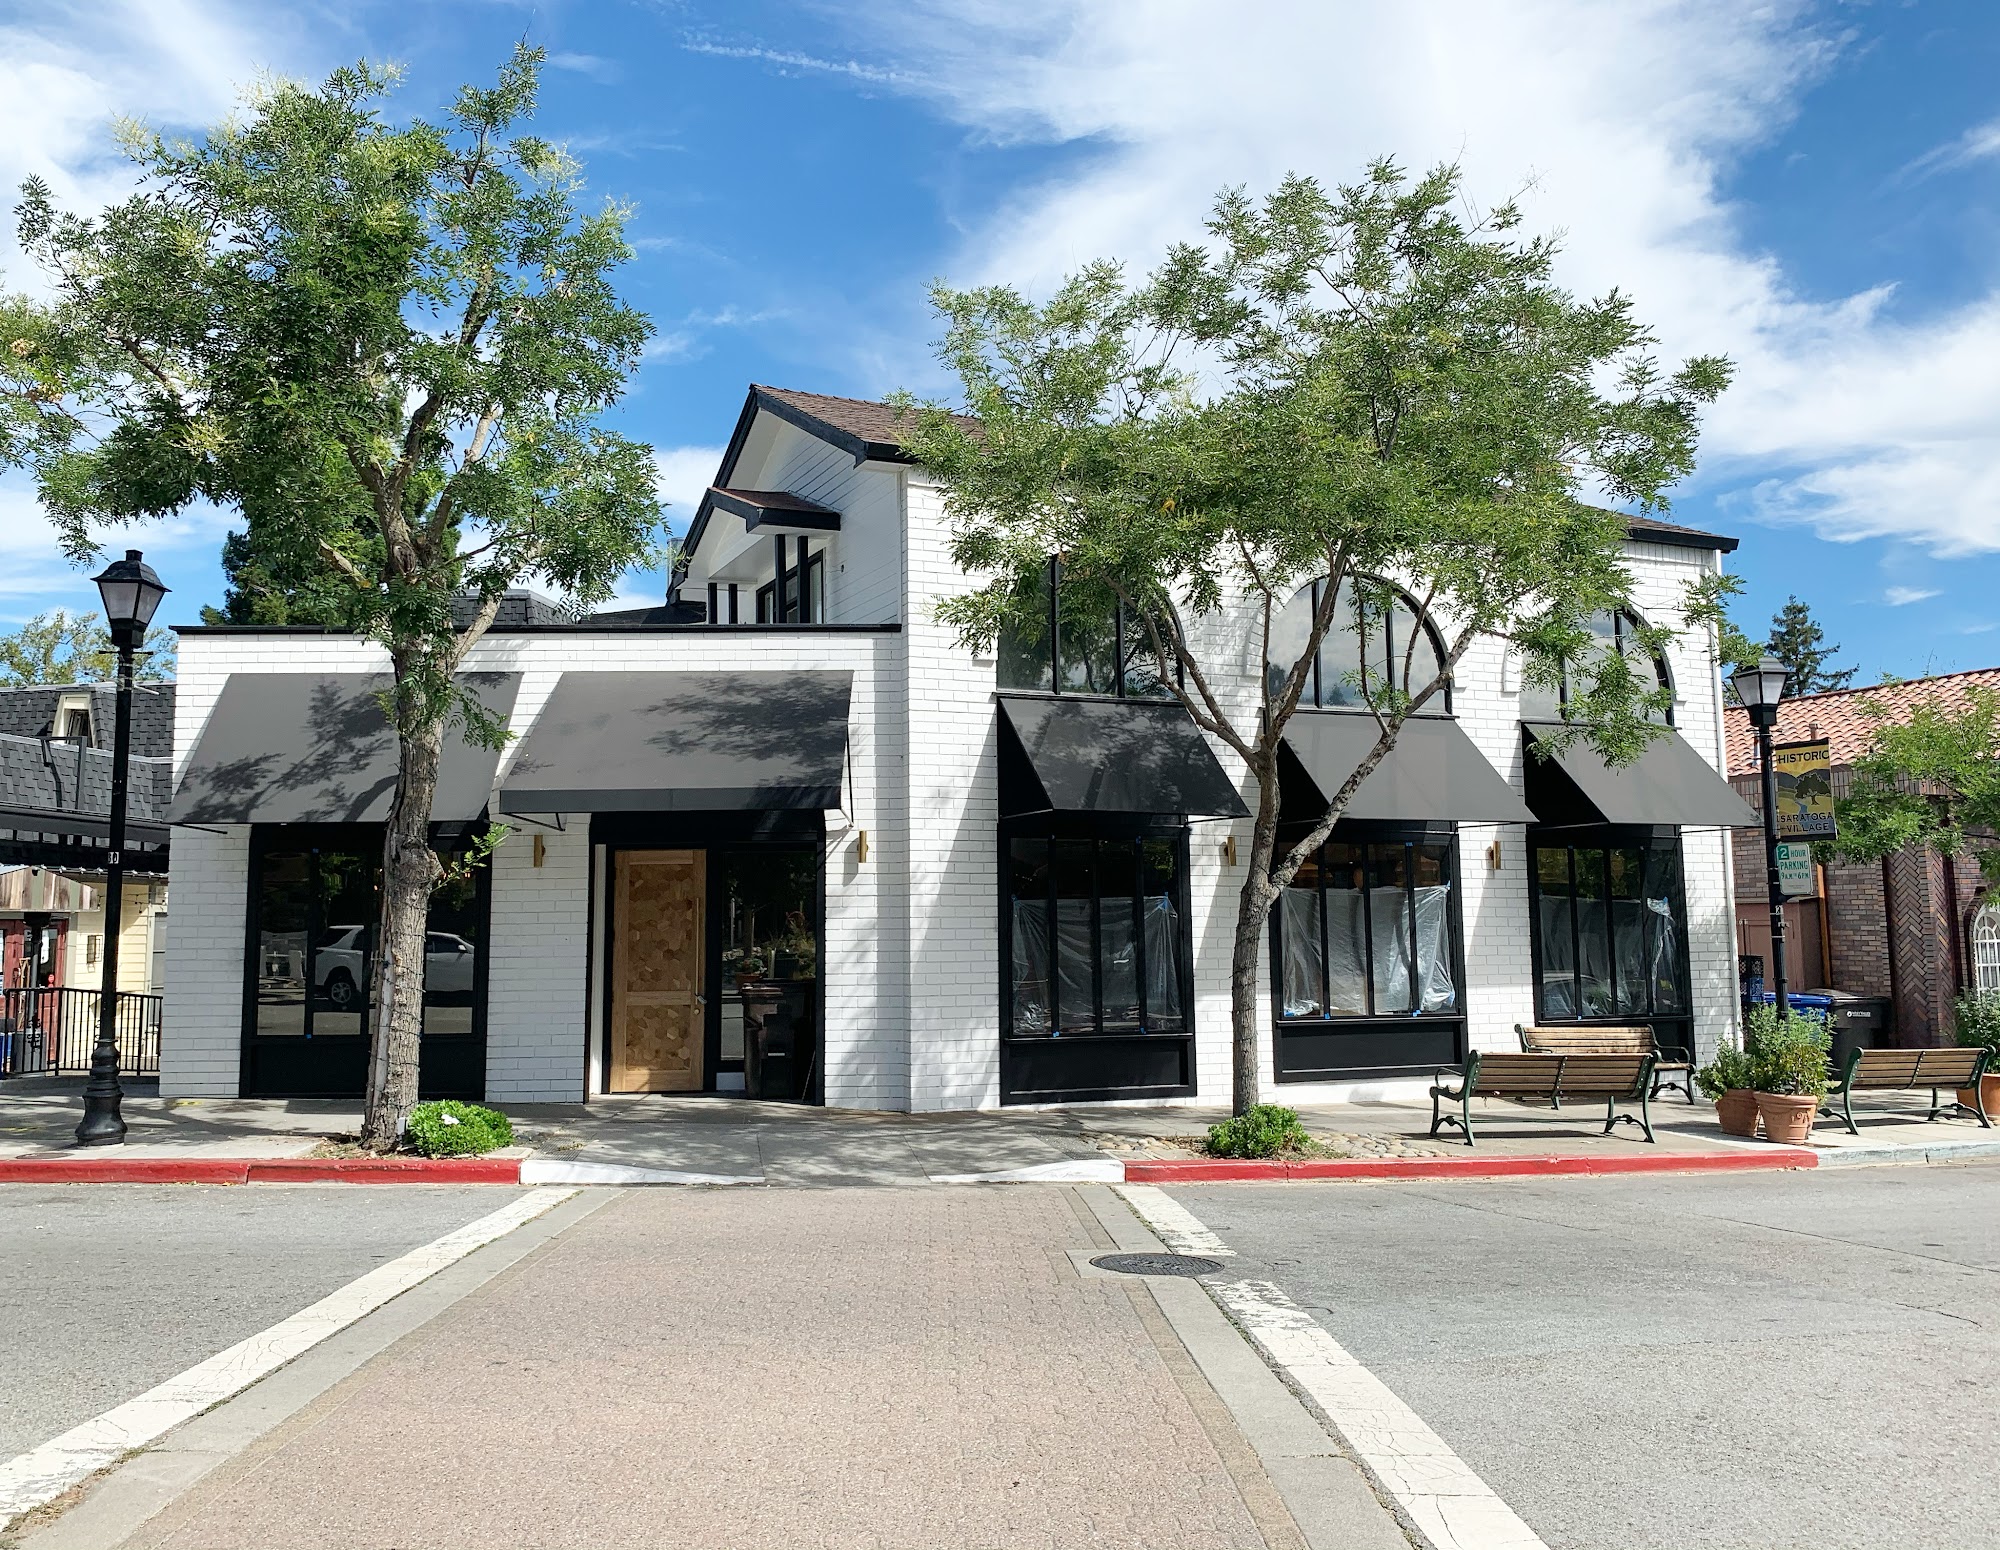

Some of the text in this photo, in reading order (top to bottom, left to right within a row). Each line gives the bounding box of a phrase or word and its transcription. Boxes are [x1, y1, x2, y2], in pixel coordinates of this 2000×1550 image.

[1778, 750, 1830, 764] HISTORIC
[1780, 812, 1834, 822] SARATOGA
[1786, 823, 1829, 832] VILLAGE
[1780, 848, 1806, 858] 2 HOUR
[1780, 861, 1808, 870] PARKING
